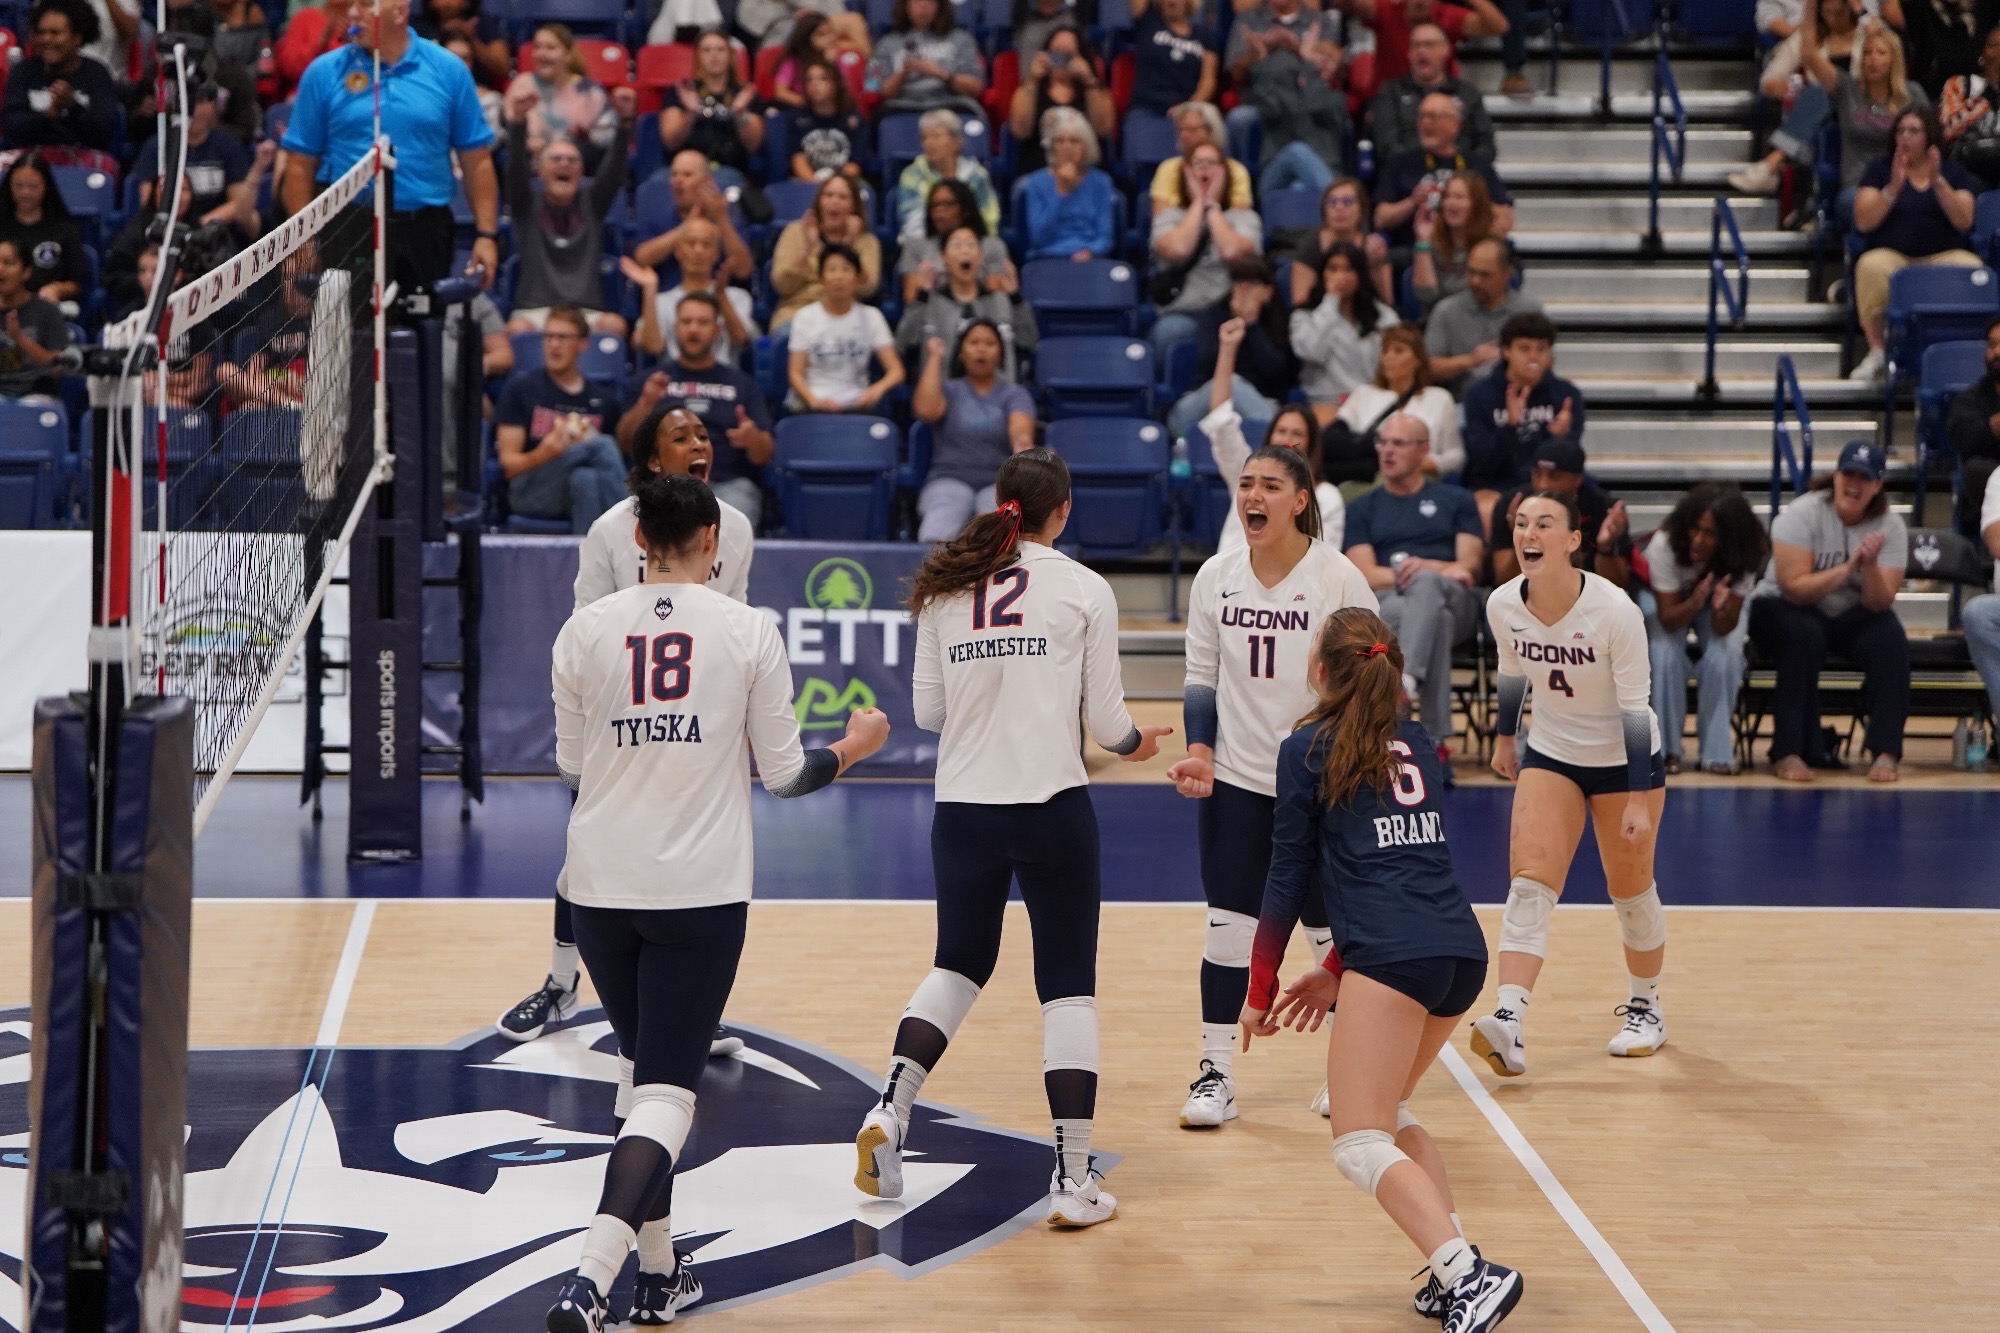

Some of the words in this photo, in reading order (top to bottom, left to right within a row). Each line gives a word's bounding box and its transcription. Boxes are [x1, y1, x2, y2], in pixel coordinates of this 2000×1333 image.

[973, 566, 1030, 631] 12
[1220, 605, 1309, 631] UCONN
[377, 650, 396, 708] sports
[625, 632, 694, 706] 18
[949, 637, 1047, 664] WERKMESTER
[1247, 634, 1276, 679] 11
[1548, 669, 1575, 698] 4
[377, 709, 396, 780] imports
[1385, 738, 1427, 807] 6
